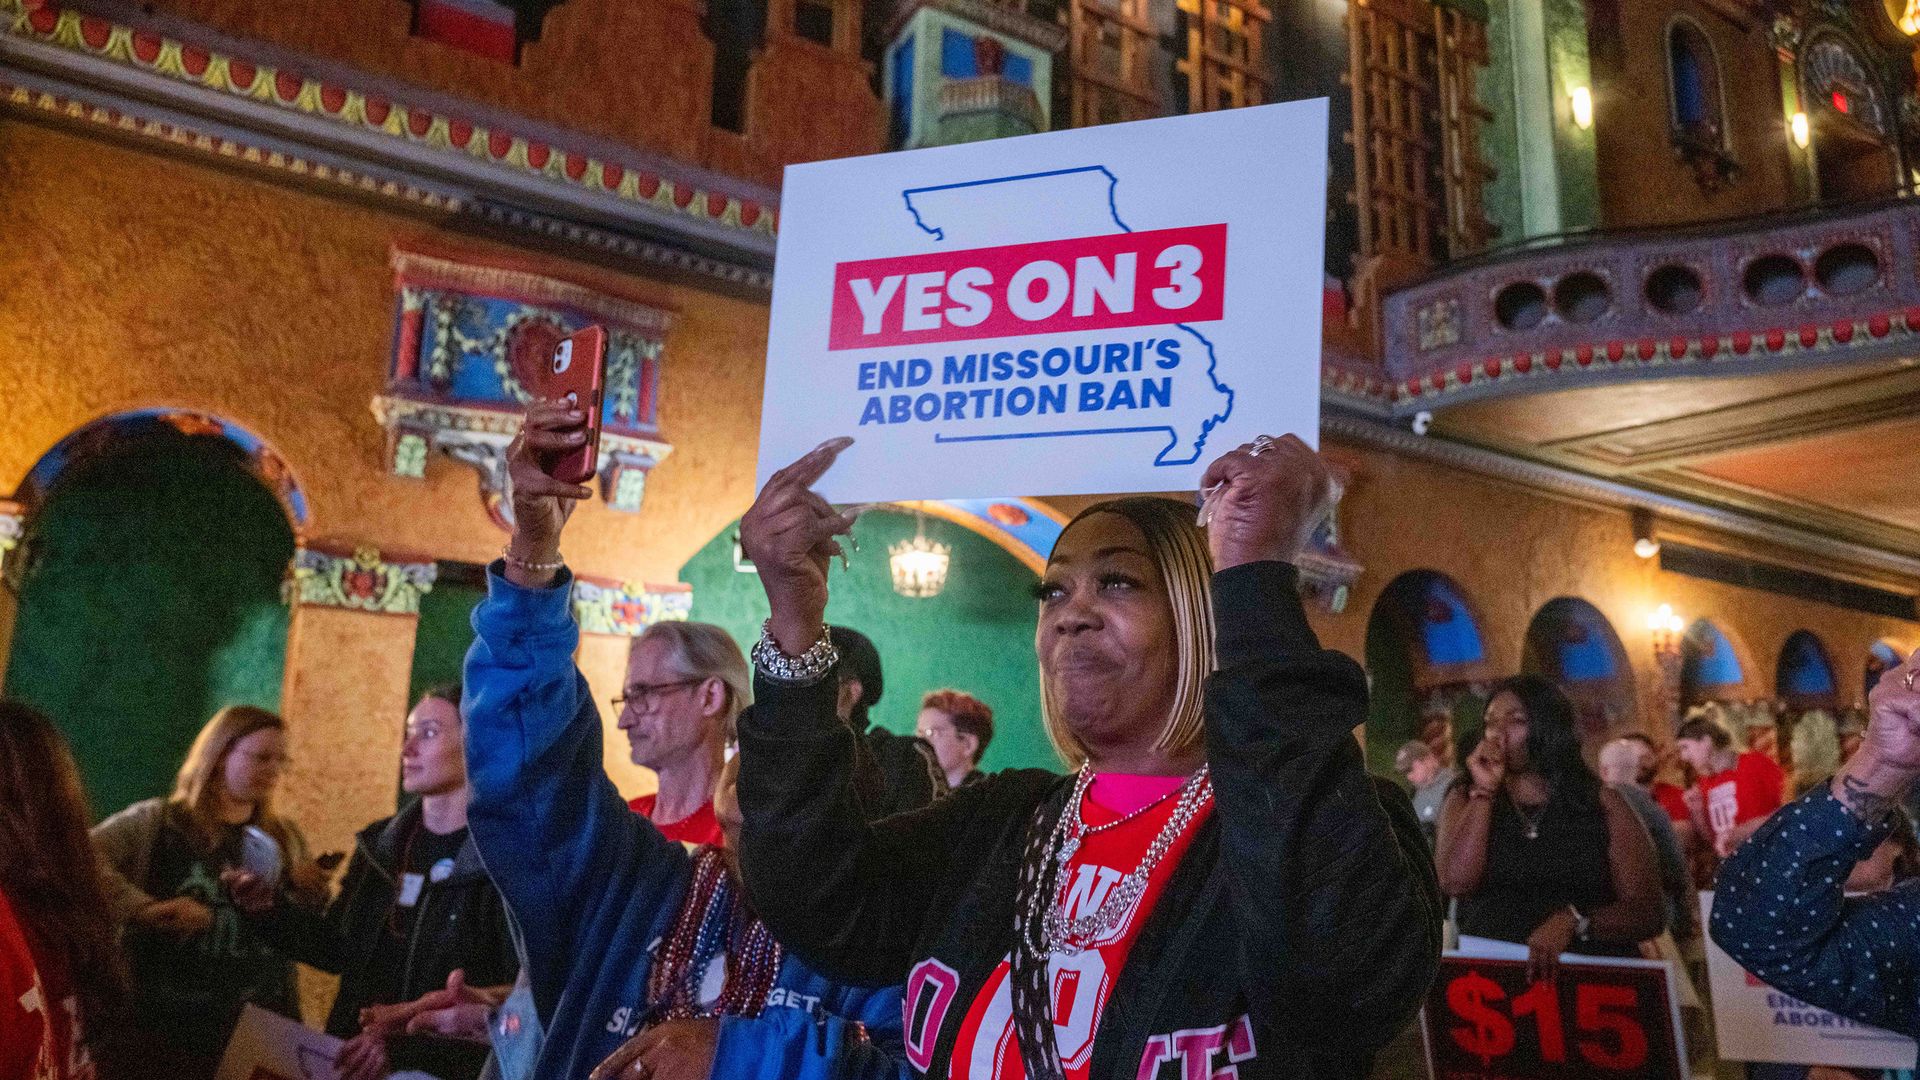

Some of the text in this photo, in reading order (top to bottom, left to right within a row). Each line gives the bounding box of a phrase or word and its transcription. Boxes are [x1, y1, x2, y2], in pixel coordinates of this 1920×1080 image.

[849, 245, 1204, 335] YES ON 3
[858, 338, 1181, 391] END MISSOURI'S
[859, 377, 1173, 426] ABORTION BAN
[1445, 970, 1648, 1071] $15
